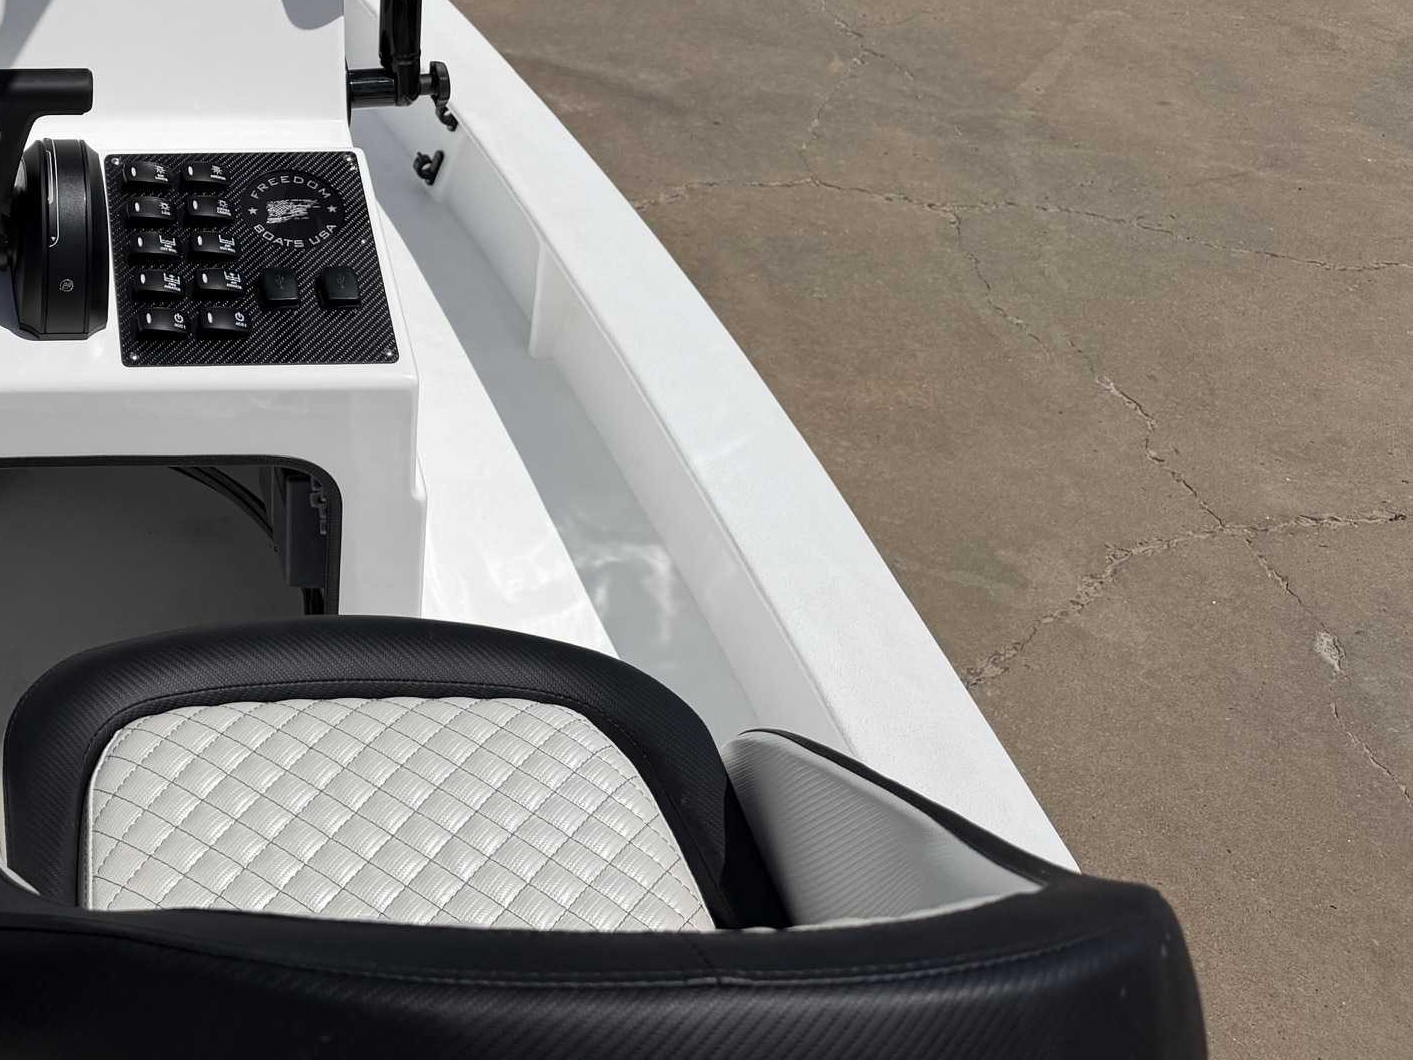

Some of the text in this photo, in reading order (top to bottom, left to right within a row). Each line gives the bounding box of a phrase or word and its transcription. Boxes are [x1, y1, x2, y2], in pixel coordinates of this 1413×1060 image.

[250, 175, 331, 199] FREEDOM
[253, 224, 337, 248] BOATS USA
